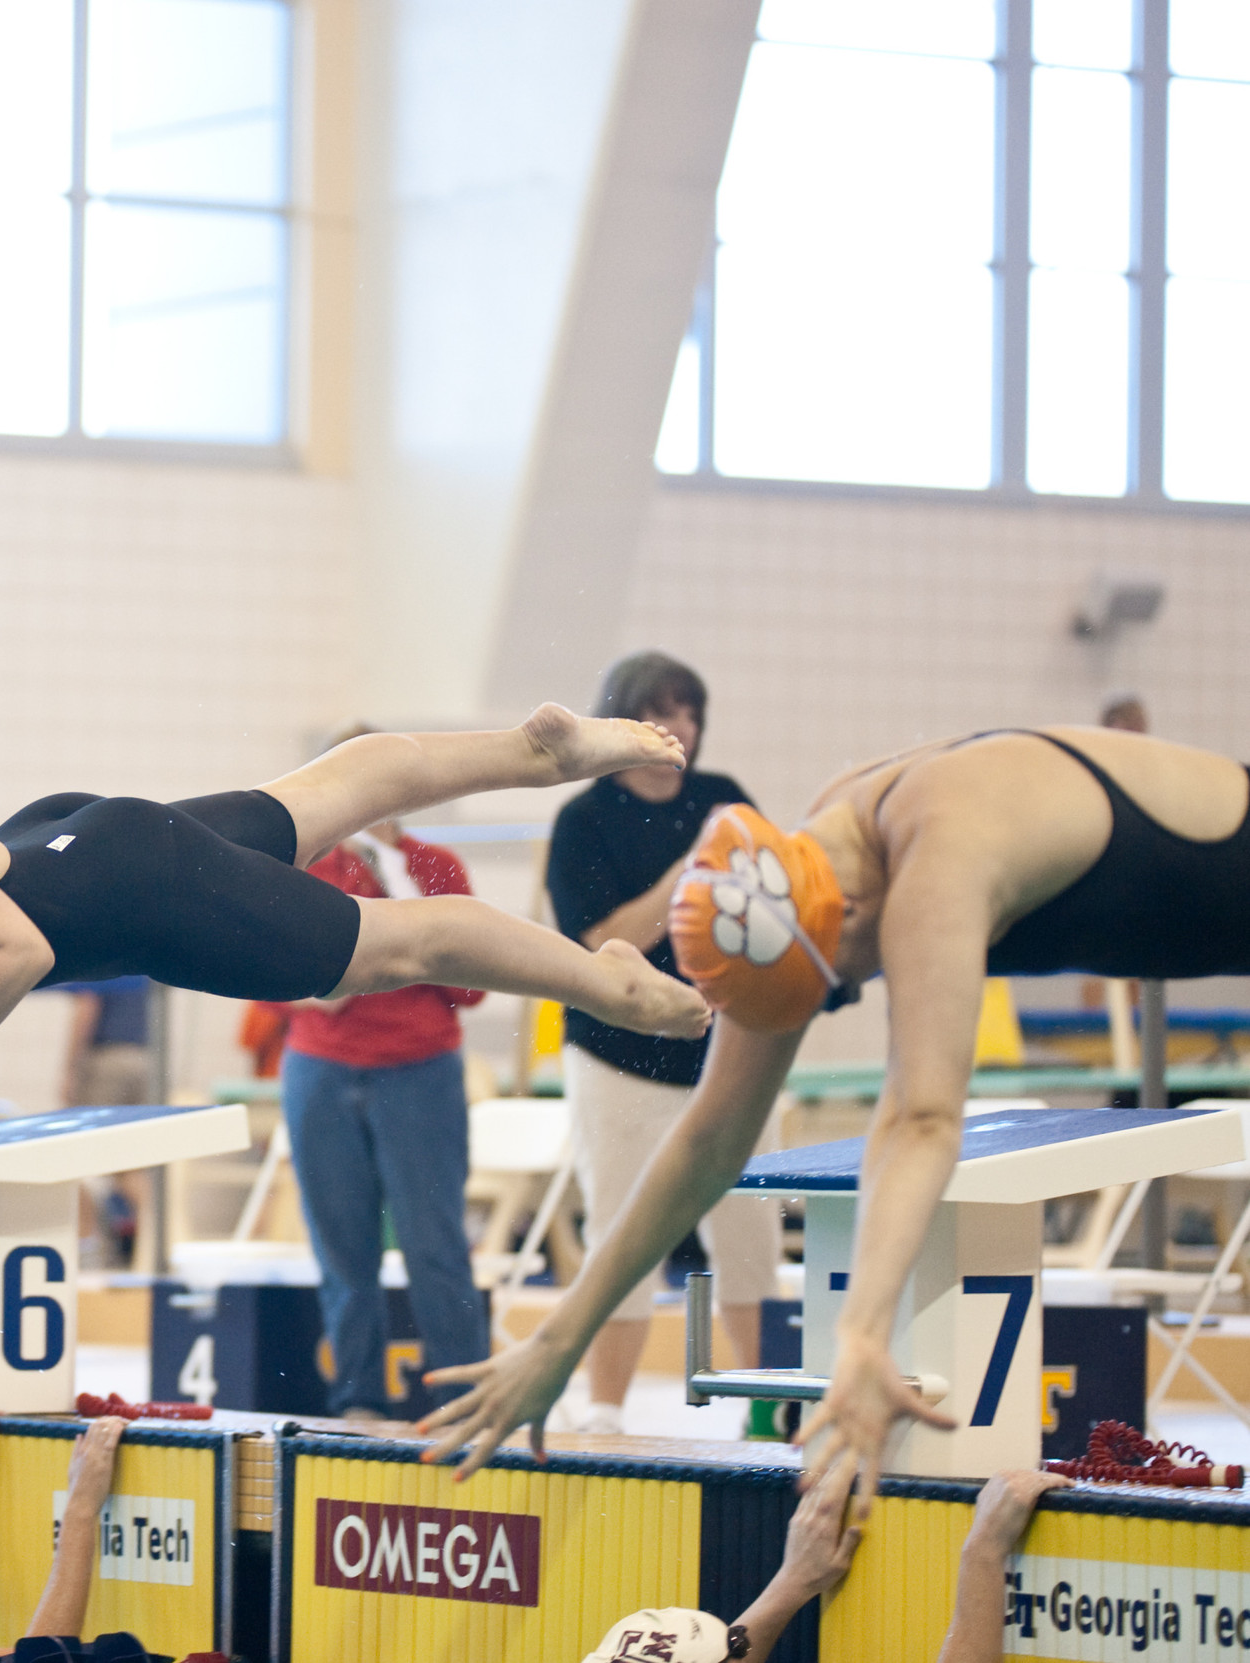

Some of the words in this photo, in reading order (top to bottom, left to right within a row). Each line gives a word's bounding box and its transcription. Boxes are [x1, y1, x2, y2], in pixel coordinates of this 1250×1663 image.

[2, 1245, 65, 1371] 6
[178, 1334, 217, 1406] 4
[962, 1275, 1034, 1426] 7
[133, 1516, 189, 1562] Tech
[333, 1514, 521, 1592] OMEGA
[1051, 1581, 1181, 1651] Georgia
[1194, 1593, 1250, 1650] Tec
